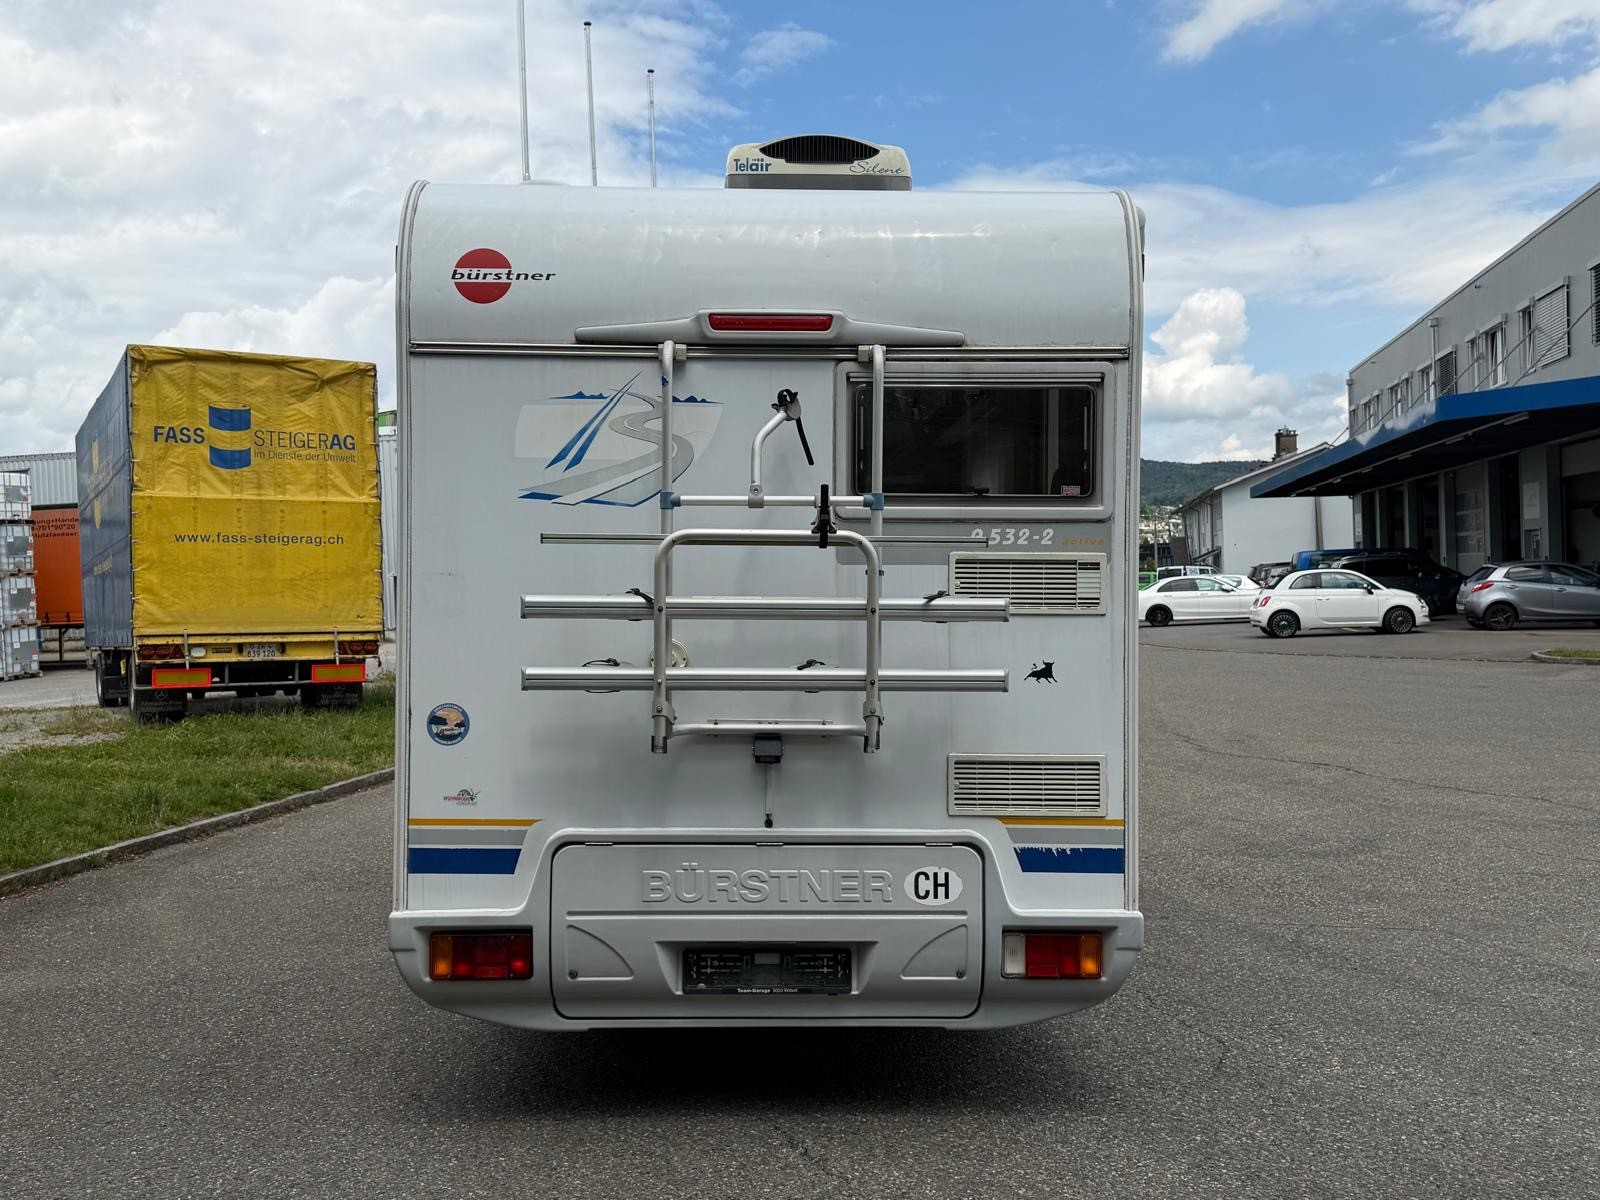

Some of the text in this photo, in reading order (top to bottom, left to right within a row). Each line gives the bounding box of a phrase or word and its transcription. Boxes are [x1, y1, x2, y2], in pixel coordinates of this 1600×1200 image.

[733, 157, 772, 172] Telair
[849, 160, 903, 174] Silent
[451, 269, 556, 281] bürstner
[153, 425, 205, 444] FASS
[254, 430, 356, 450] STEIGERAG
[268, 451, 303, 461] Dienste
[305, 452, 321, 462] der
[323, 453, 356, 463] Umwelt
[174, 532, 344, 547] www.fass-steigerag.ch
[988, 528, 1054, 545] 532-2
[642, 862, 893, 903] BÜRSTNER
[913, 871, 950, 900] CH
